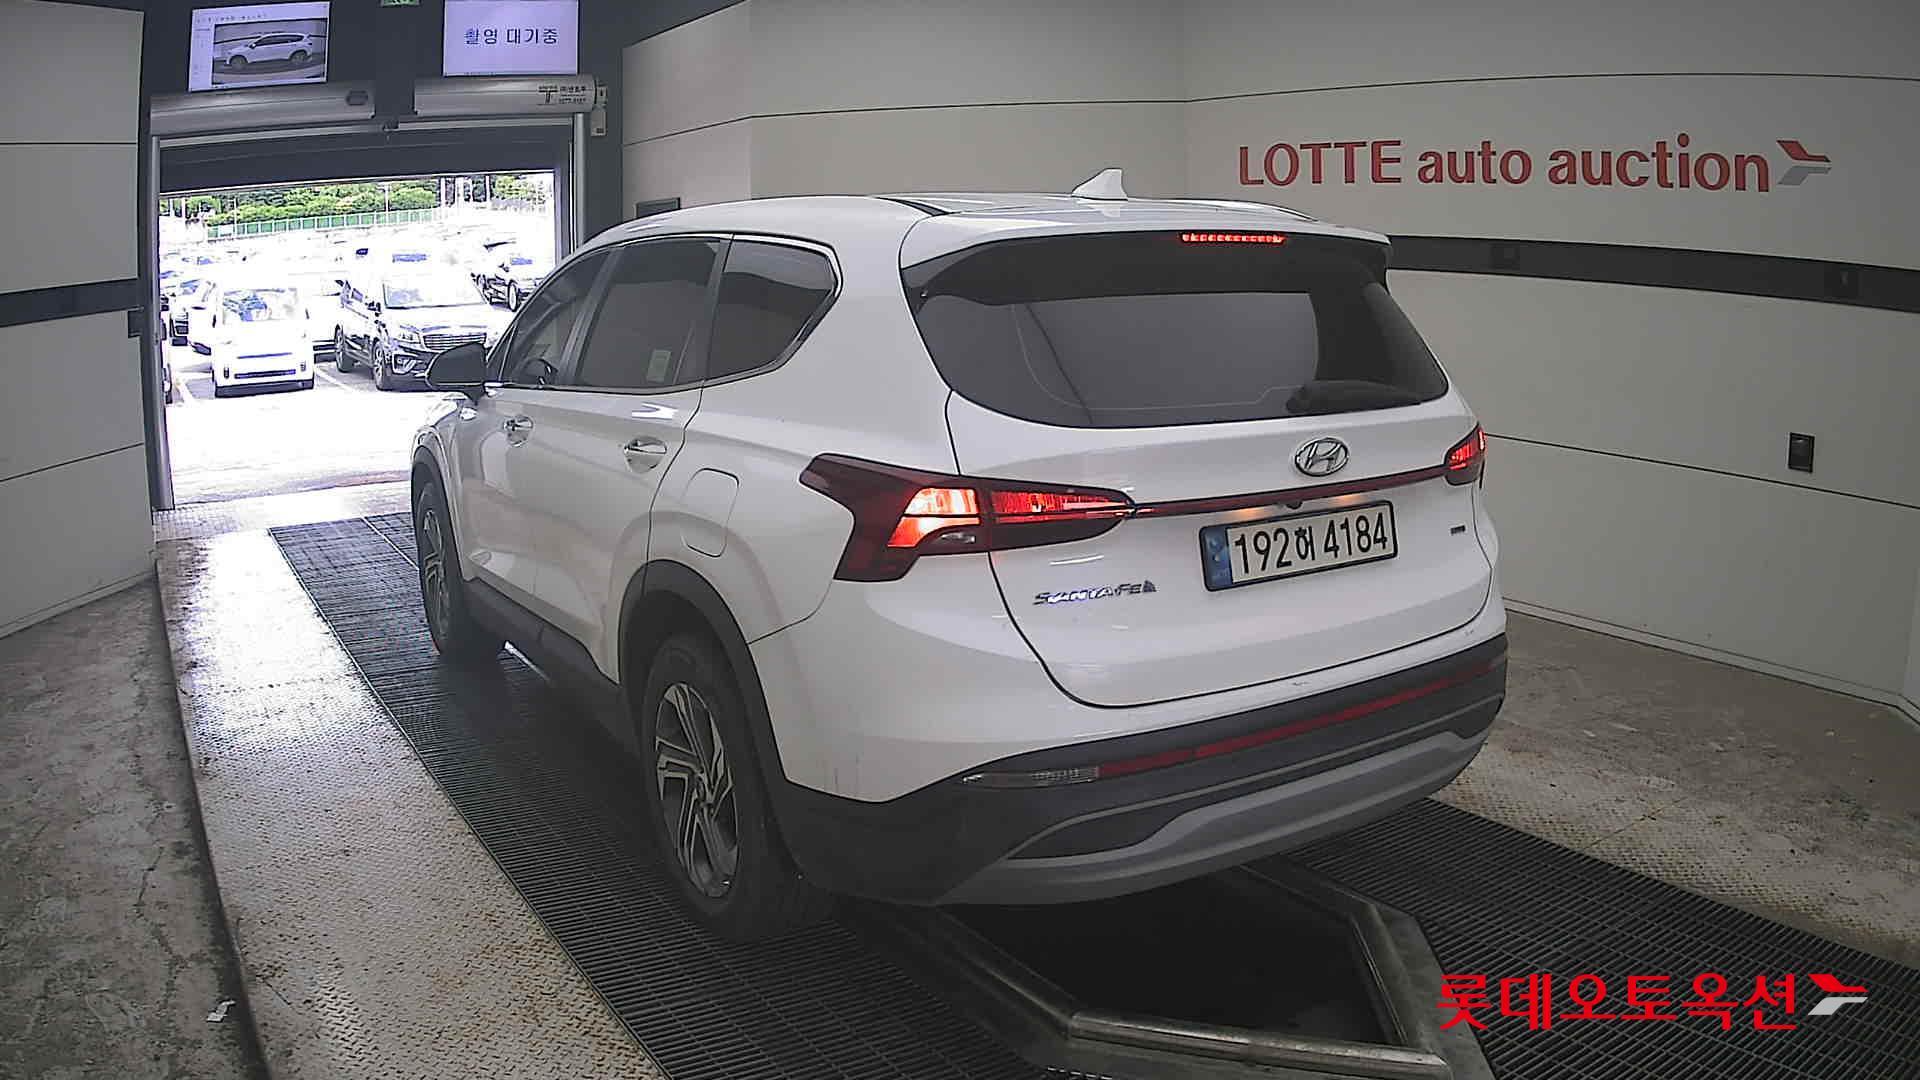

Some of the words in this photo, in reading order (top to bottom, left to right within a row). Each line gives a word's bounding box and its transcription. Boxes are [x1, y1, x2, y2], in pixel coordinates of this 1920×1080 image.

[506, 28, 557, 45] 대기중
[1238, 139, 1401, 187] LOTTE
[1417, 140, 1532, 186] auto
[1547, 132, 1770, 193] auction
[1323, 511, 1388, 559] 4184
